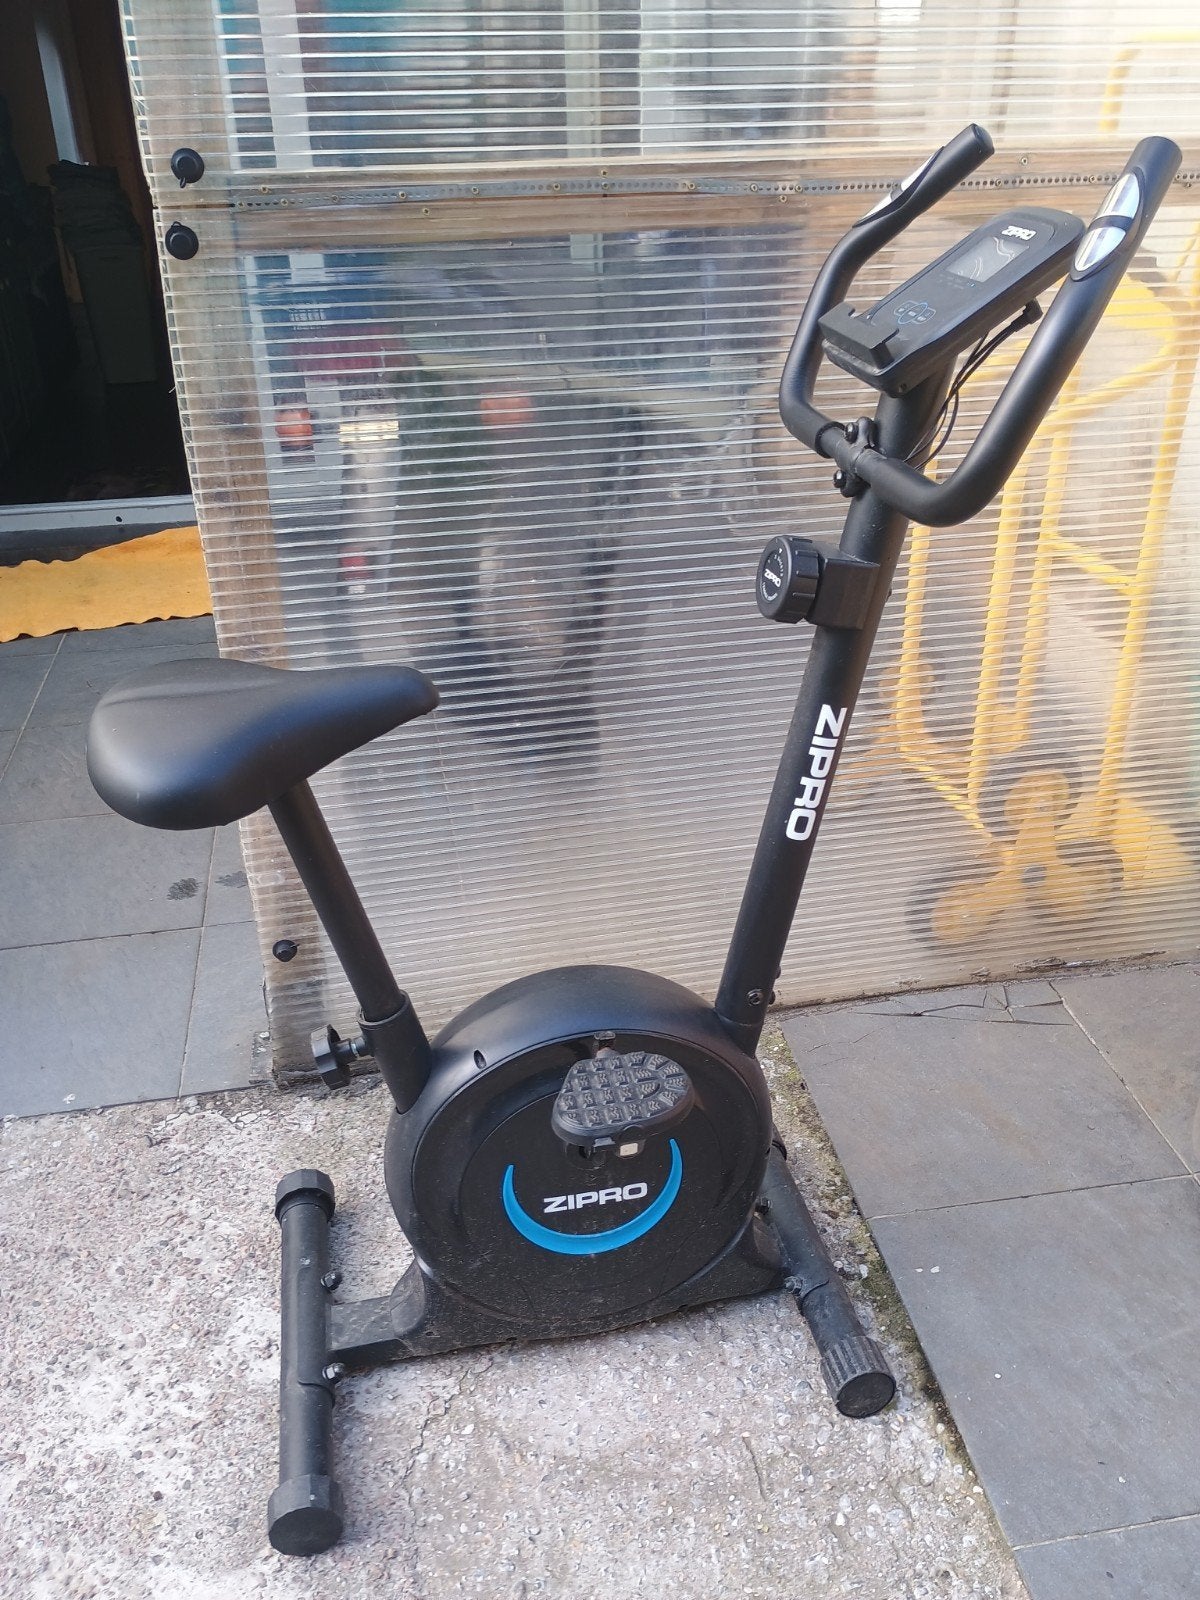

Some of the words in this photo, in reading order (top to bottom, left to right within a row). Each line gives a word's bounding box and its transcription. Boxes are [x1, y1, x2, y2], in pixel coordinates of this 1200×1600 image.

[1001, 225, 1037, 241] ZIPRO
[785, 703, 848, 841] ZIPRO
[543, 1182, 648, 1214] ZIPRO
